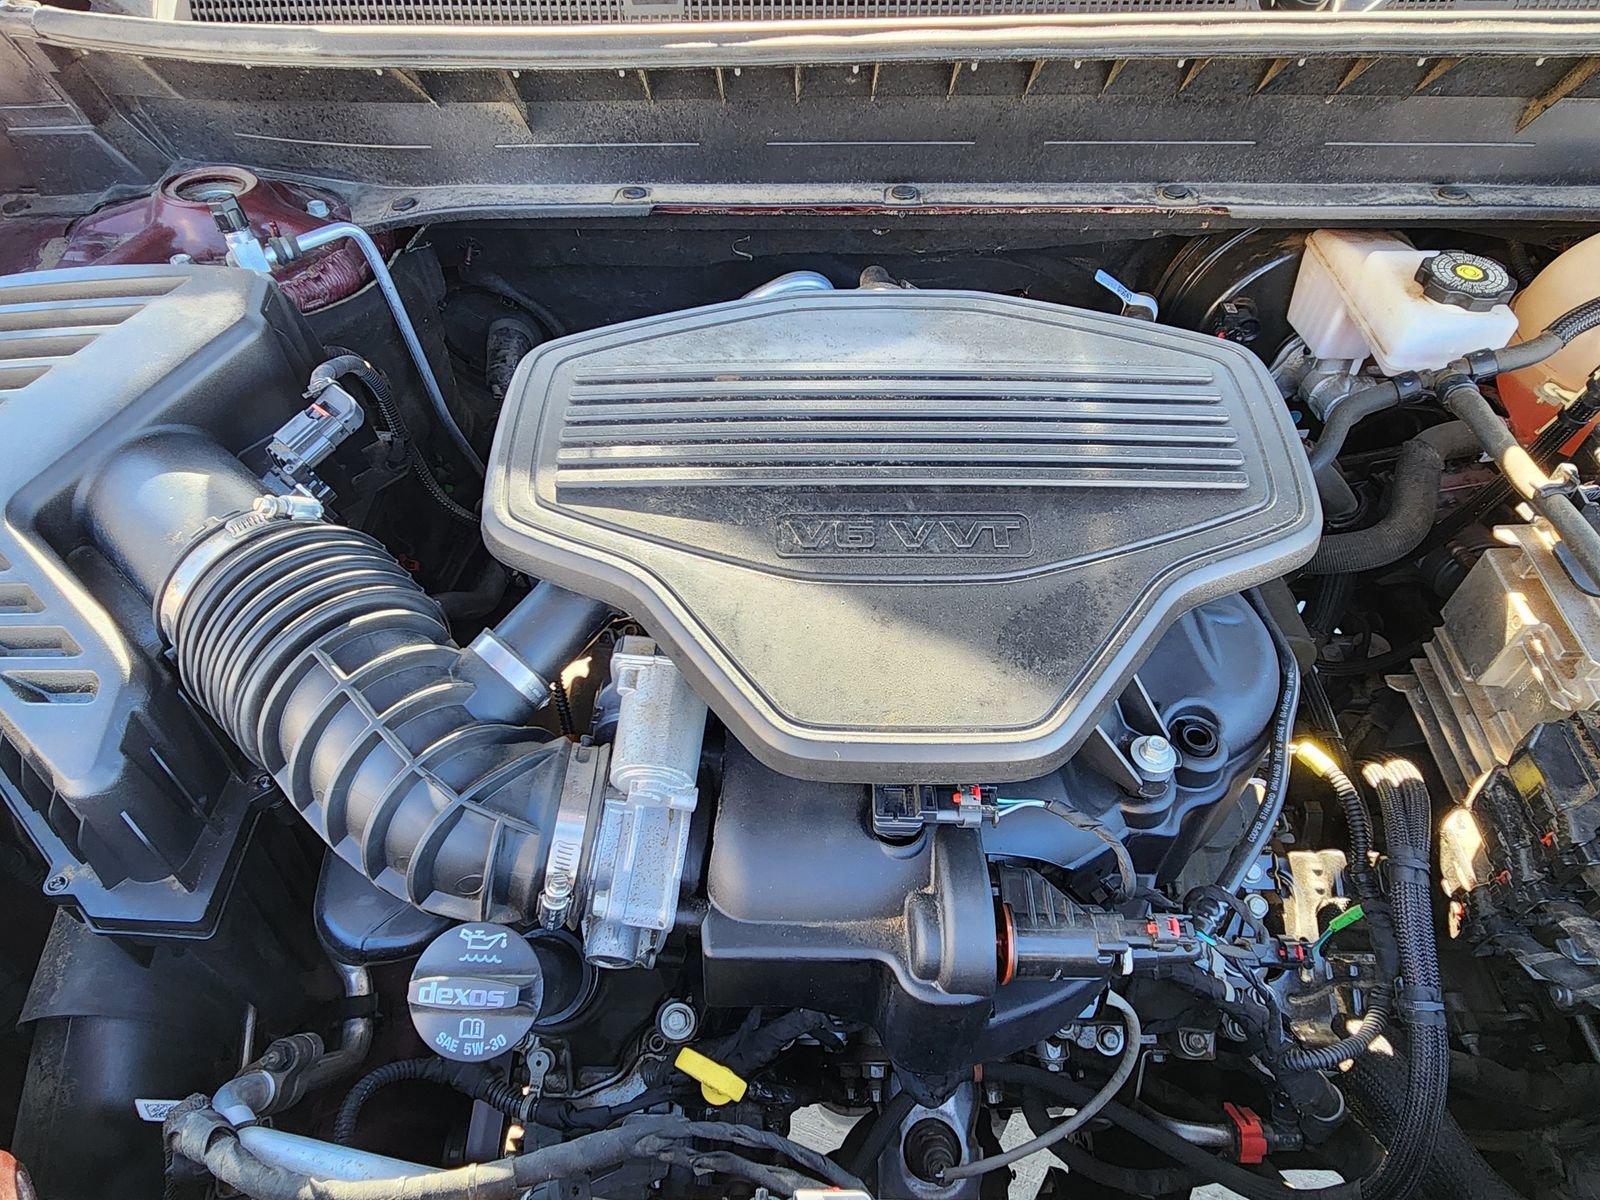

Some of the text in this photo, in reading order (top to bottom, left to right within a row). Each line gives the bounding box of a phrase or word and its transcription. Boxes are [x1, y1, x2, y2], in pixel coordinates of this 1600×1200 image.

[785, 520, 1021, 548] V6 VVT
[1247, 821, 1264, 843] COOPER
[418, 981, 505, 1008] dexos
[435, 1031, 507, 1056] SAE 5W-30
